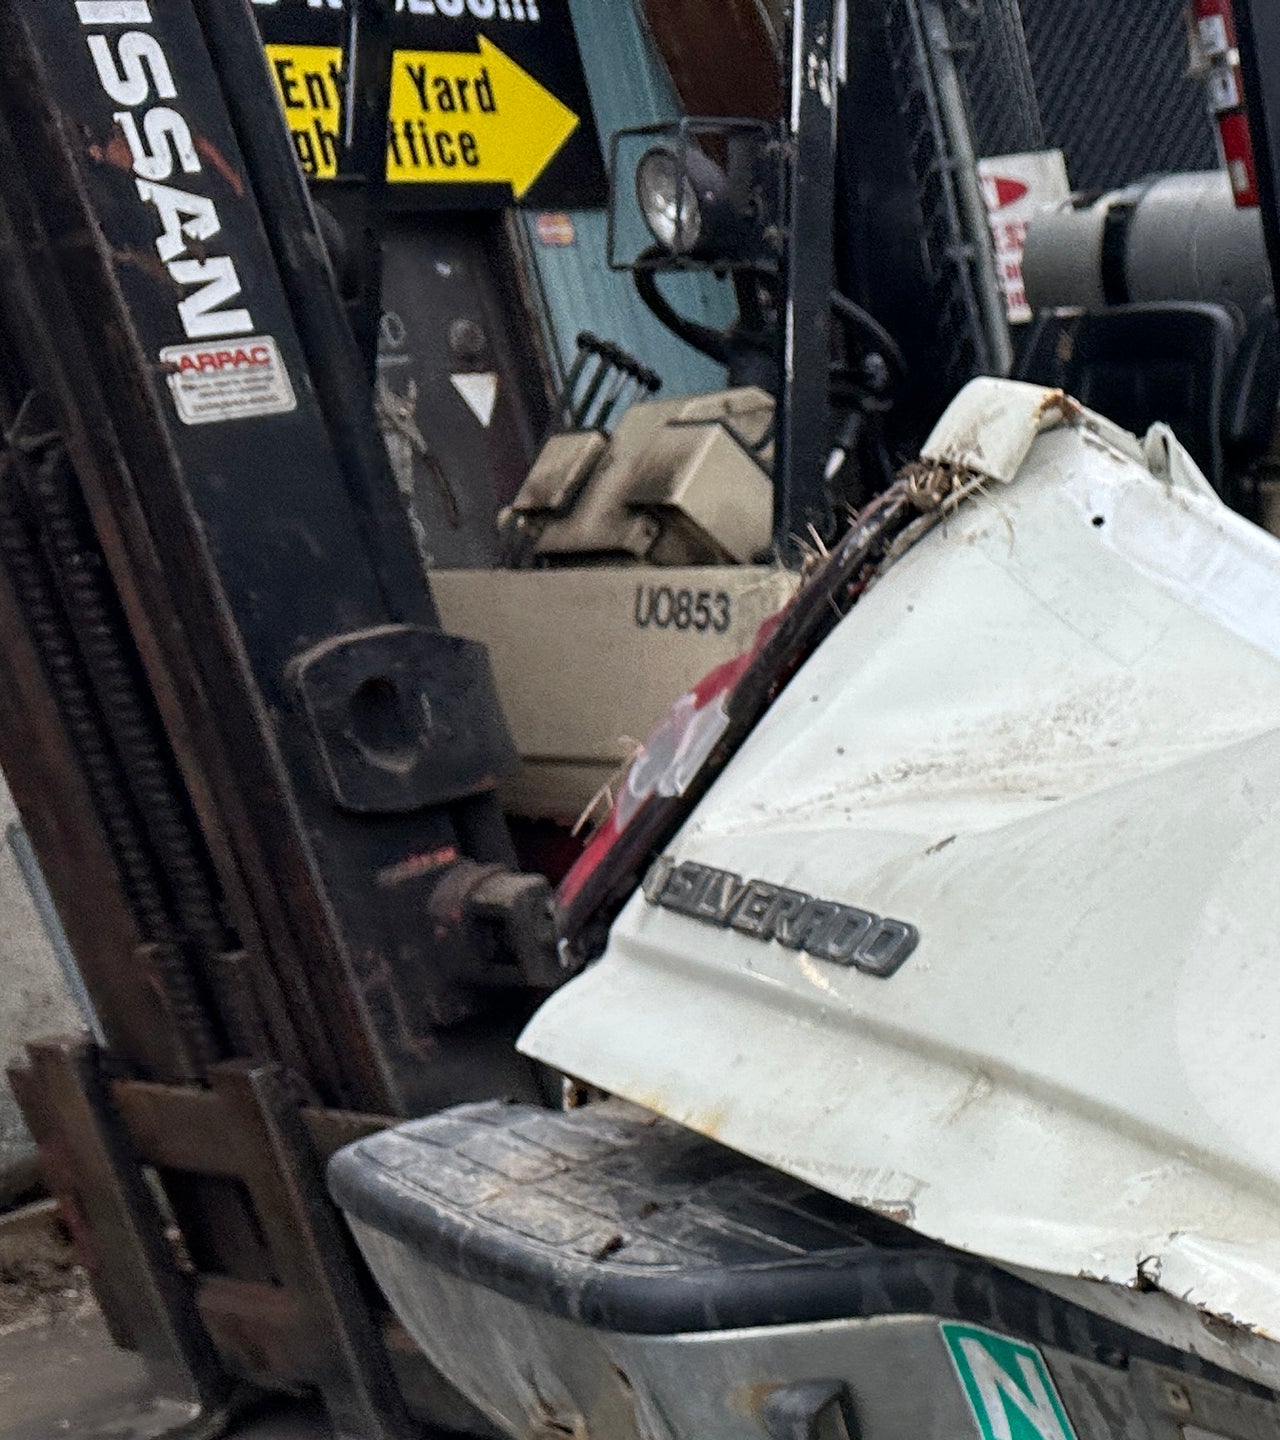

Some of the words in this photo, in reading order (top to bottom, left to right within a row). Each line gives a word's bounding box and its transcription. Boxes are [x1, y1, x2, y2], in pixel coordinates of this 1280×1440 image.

[404, 63, 497, 113] Yard
[388, 118, 480, 167] ffice
[74, 0, 254, 338] ISSAN
